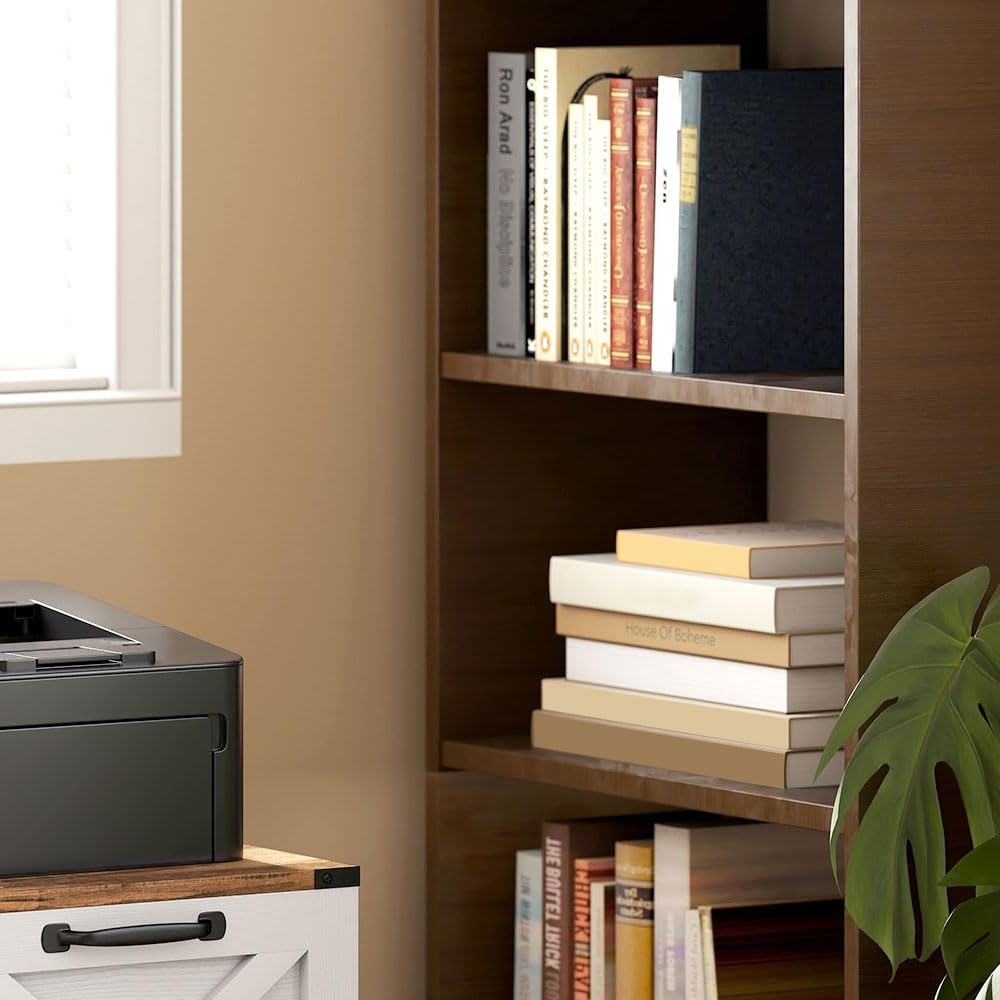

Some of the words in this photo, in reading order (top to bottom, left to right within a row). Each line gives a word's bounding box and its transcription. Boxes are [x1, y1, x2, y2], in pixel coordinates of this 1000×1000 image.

[499, 68, 514, 105] Ron
[499, 110, 514, 156] Arad
[542, 177, 550, 245] RAYMOND
[542, 250, 550, 319] CHANDLER
[625, 622, 657, 639] House
[658, 625, 673, 641] Of
[674, 628, 717, 647] Boheme
